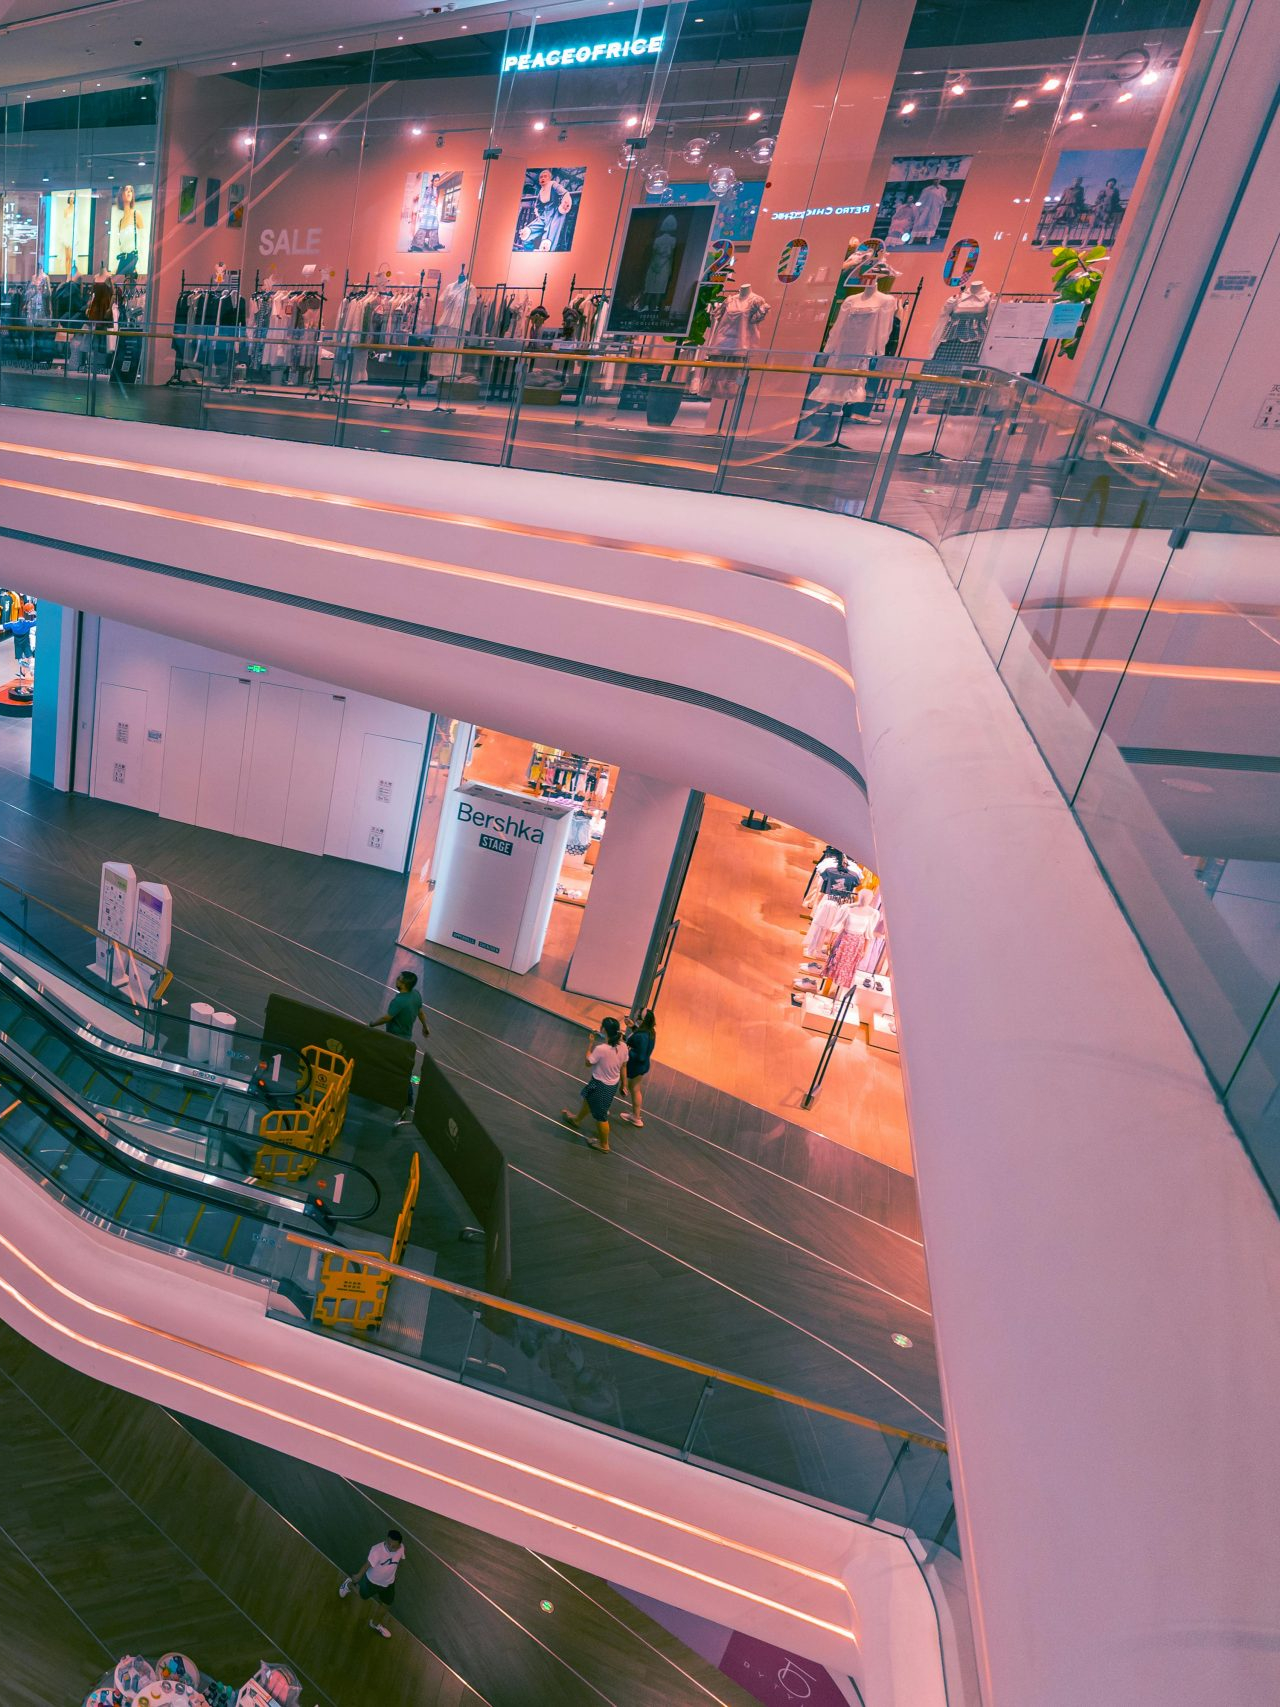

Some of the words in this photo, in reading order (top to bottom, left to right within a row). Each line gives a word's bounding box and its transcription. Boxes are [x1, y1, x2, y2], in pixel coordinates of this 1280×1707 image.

[502, 35, 664, 71] PEACEOFRICE
[259, 227, 322, 256] SALE
[457, 802, 544, 844] Bershka
[481, 836, 511, 854] STAGE
[272, 1054, 282, 1082] 1
[333, 1173, 345, 1204] 1
